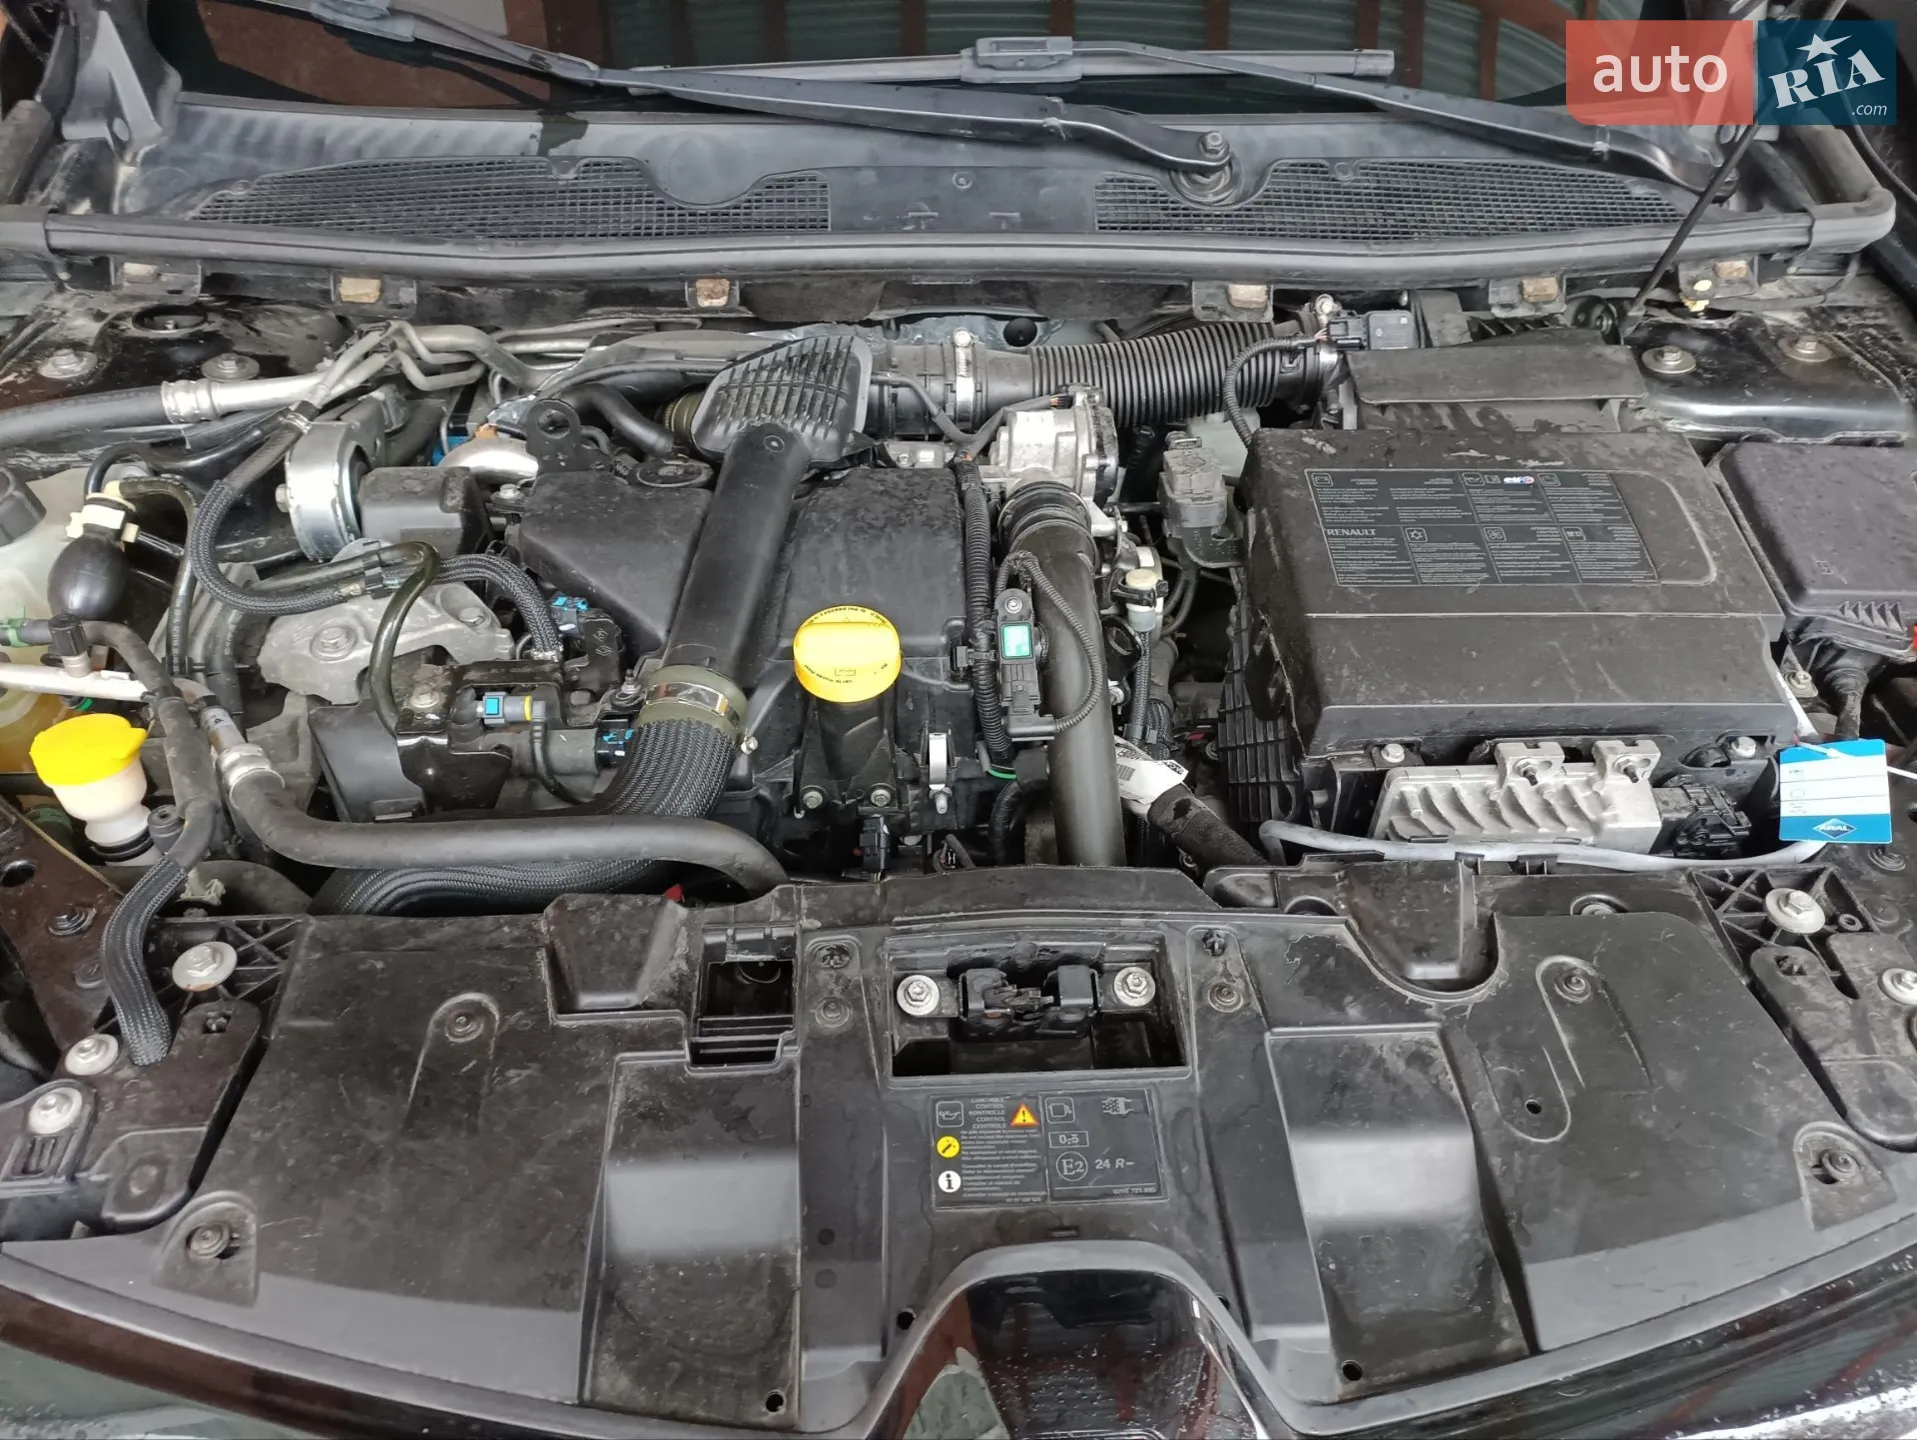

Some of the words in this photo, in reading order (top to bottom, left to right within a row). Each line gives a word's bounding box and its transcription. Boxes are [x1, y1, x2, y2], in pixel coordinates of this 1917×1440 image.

[1326, 528, 1377, 536] RENAULT
[1061, 1159, 1085, 1175] E2
[1094, 1158, 1111, 1169] 24
